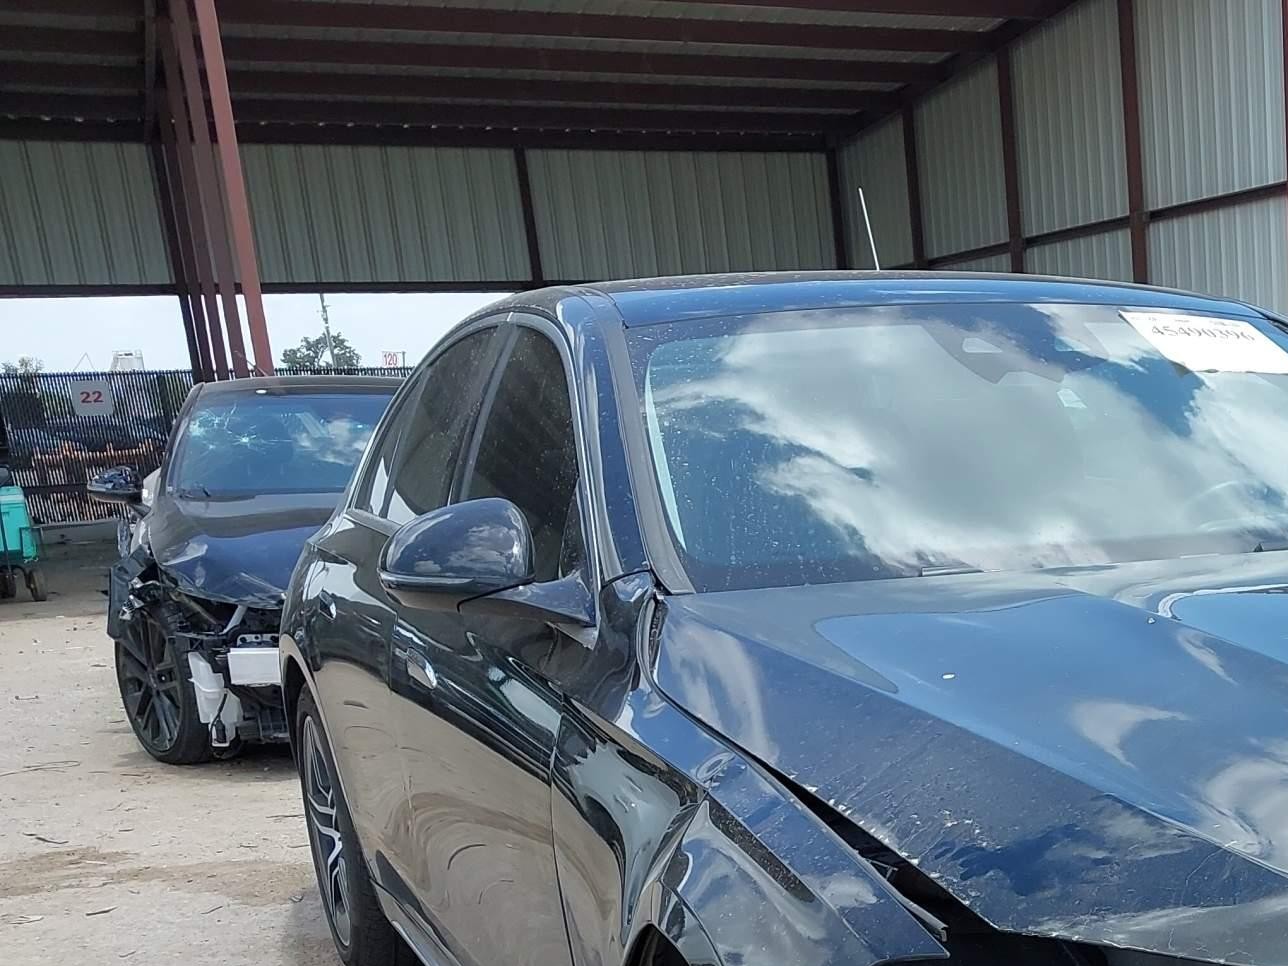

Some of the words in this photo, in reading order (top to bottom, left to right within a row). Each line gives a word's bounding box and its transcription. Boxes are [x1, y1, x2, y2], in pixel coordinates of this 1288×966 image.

[1151, 325, 1256, 342] 45490396
[383, 352, 398, 366] 120
[80, 390, 105, 404] 22
